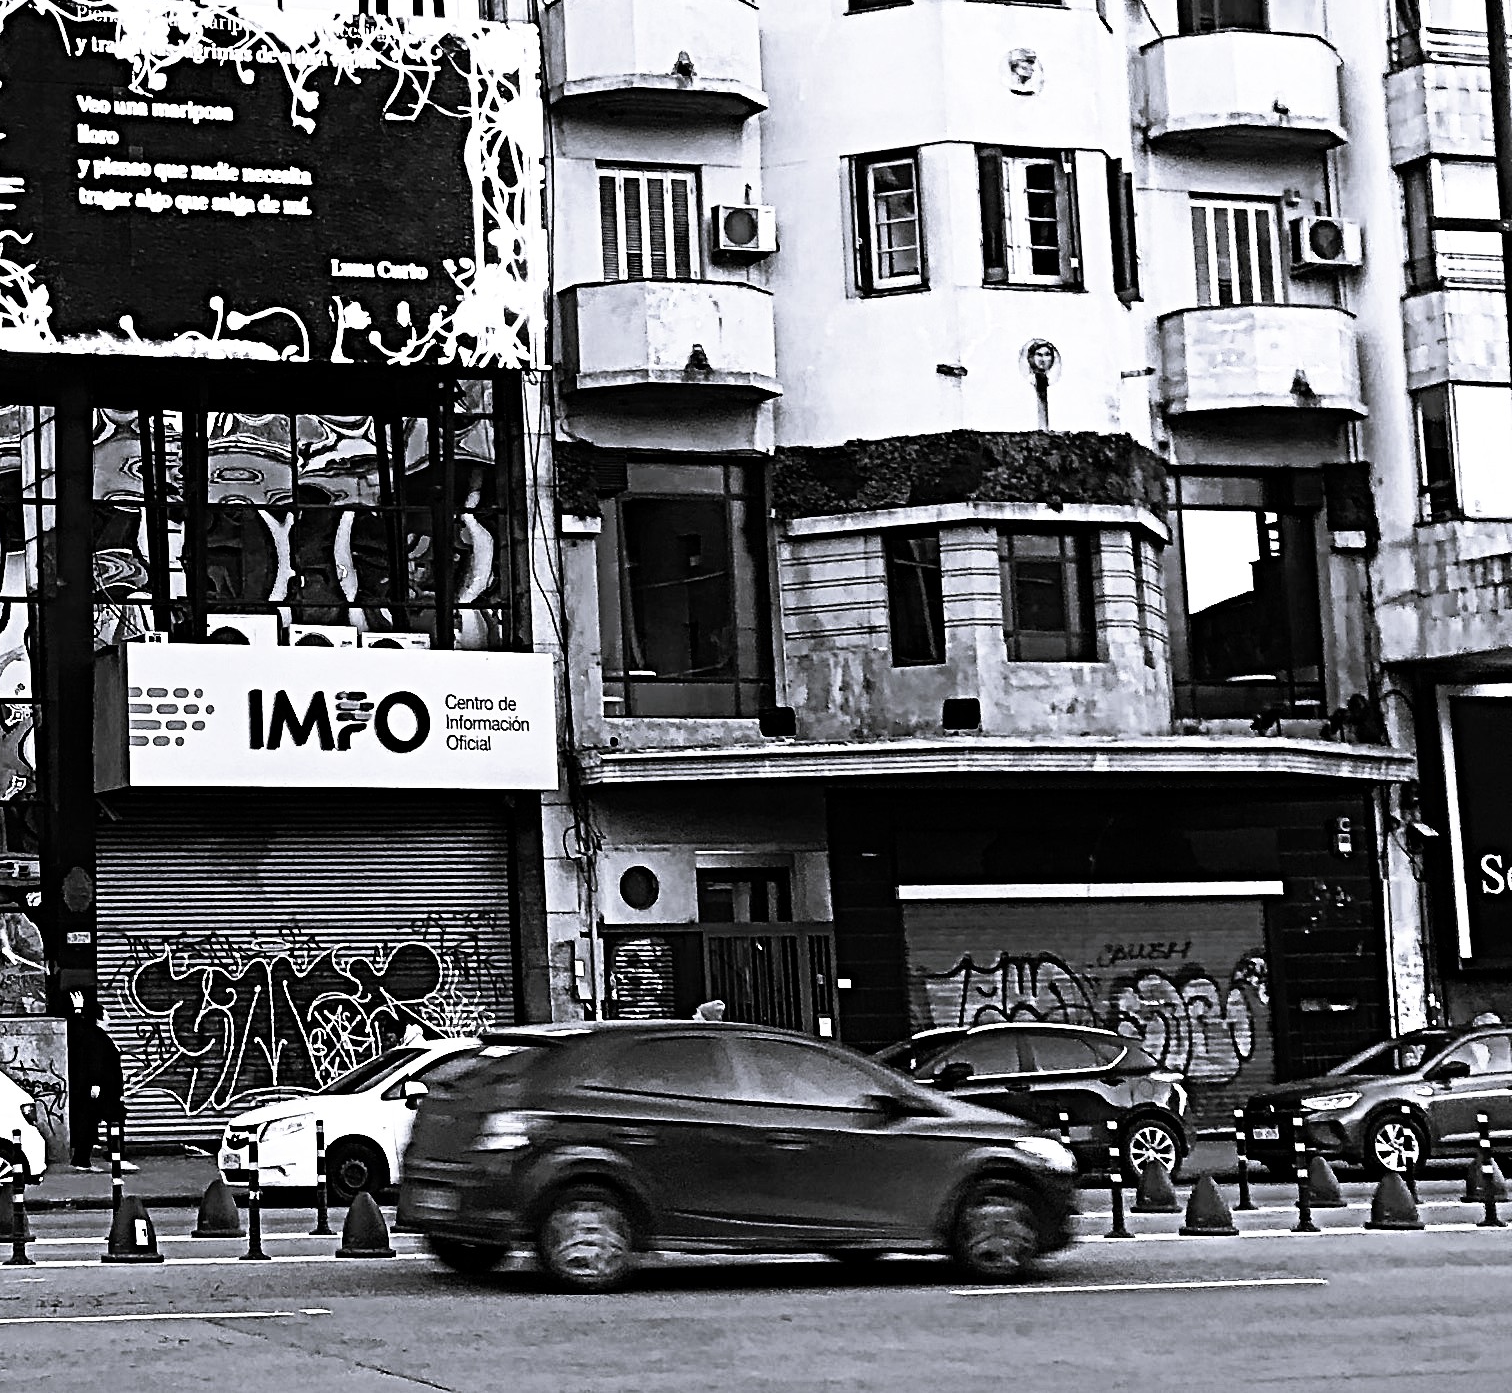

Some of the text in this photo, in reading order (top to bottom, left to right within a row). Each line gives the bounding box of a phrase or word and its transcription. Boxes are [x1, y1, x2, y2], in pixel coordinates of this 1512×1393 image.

[76, 95, 233, 124] Veo una mariposa
[77, 123, 119, 145] lloro
[78, 156, 312, 185] y pienso que nadie necesita
[175, 194, 209, 214] que
[257, 193, 280, 213] de
[445, 694, 516, 711] Centro de
[445, 714, 530, 731] Información
[446, 734, 492, 751] Oficial
[1480, 853, 1512, 895] S
